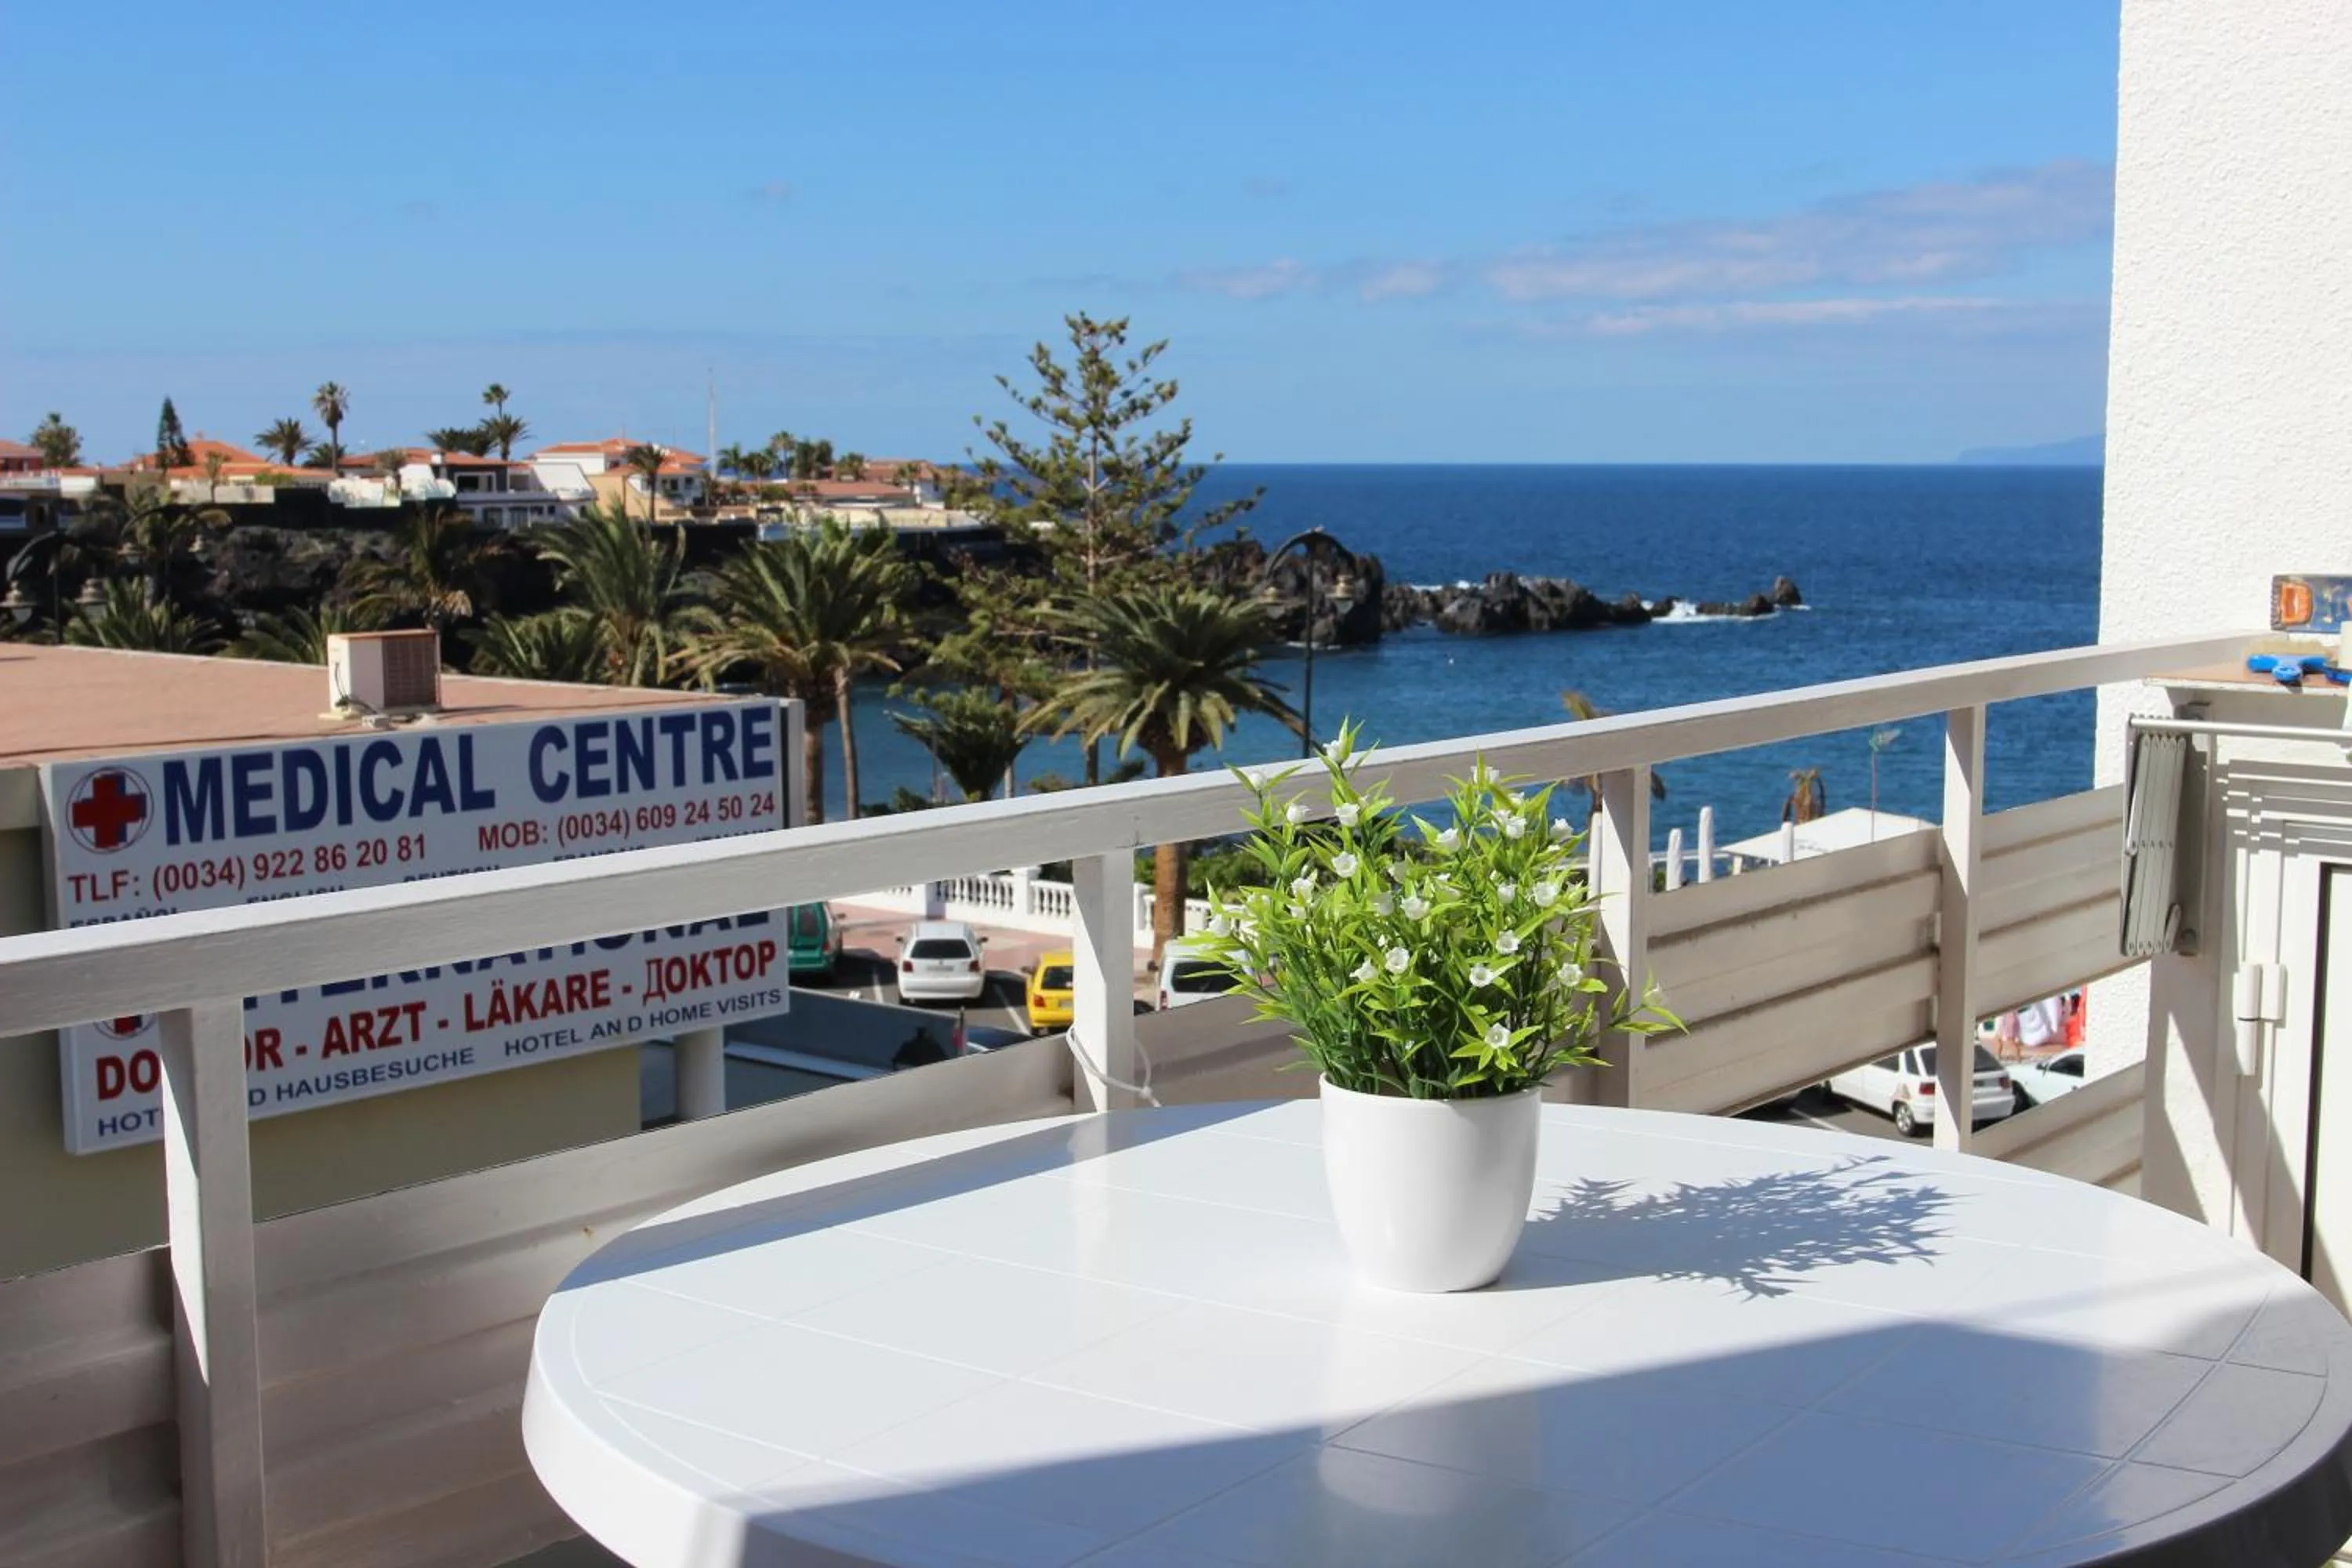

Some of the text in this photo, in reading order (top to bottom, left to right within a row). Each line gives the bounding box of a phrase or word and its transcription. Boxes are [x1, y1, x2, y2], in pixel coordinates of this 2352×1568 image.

[162, 706, 775, 846] MEDICAL CENTRE
[67, 869, 140, 903] TLF:
[153, 855, 245, 902] (0034)
[252, 848, 305, 881] 922
[314, 843, 347, 873] 86
[356, 837, 387, 868] 20
[397, 833, 425, 862] 81
[478, 820, 548, 852] MOB:
[557, 808, 630, 848] (0034)
[636, 804, 676, 831] 609
[684, 798, 710, 826] 24
[717, 795, 742, 822] 50
[750, 790, 775, 817] 24
[276, 1047, 475, 1102] HAUSBESUCHE
[504, 1028, 583, 1057] HOTEL
[649, 1002, 712, 1029] HOME
[717, 988, 782, 1015] VISITS
[321, 1000, 427, 1060] ARZT
[463, 968, 612, 1033] LÄKARE
